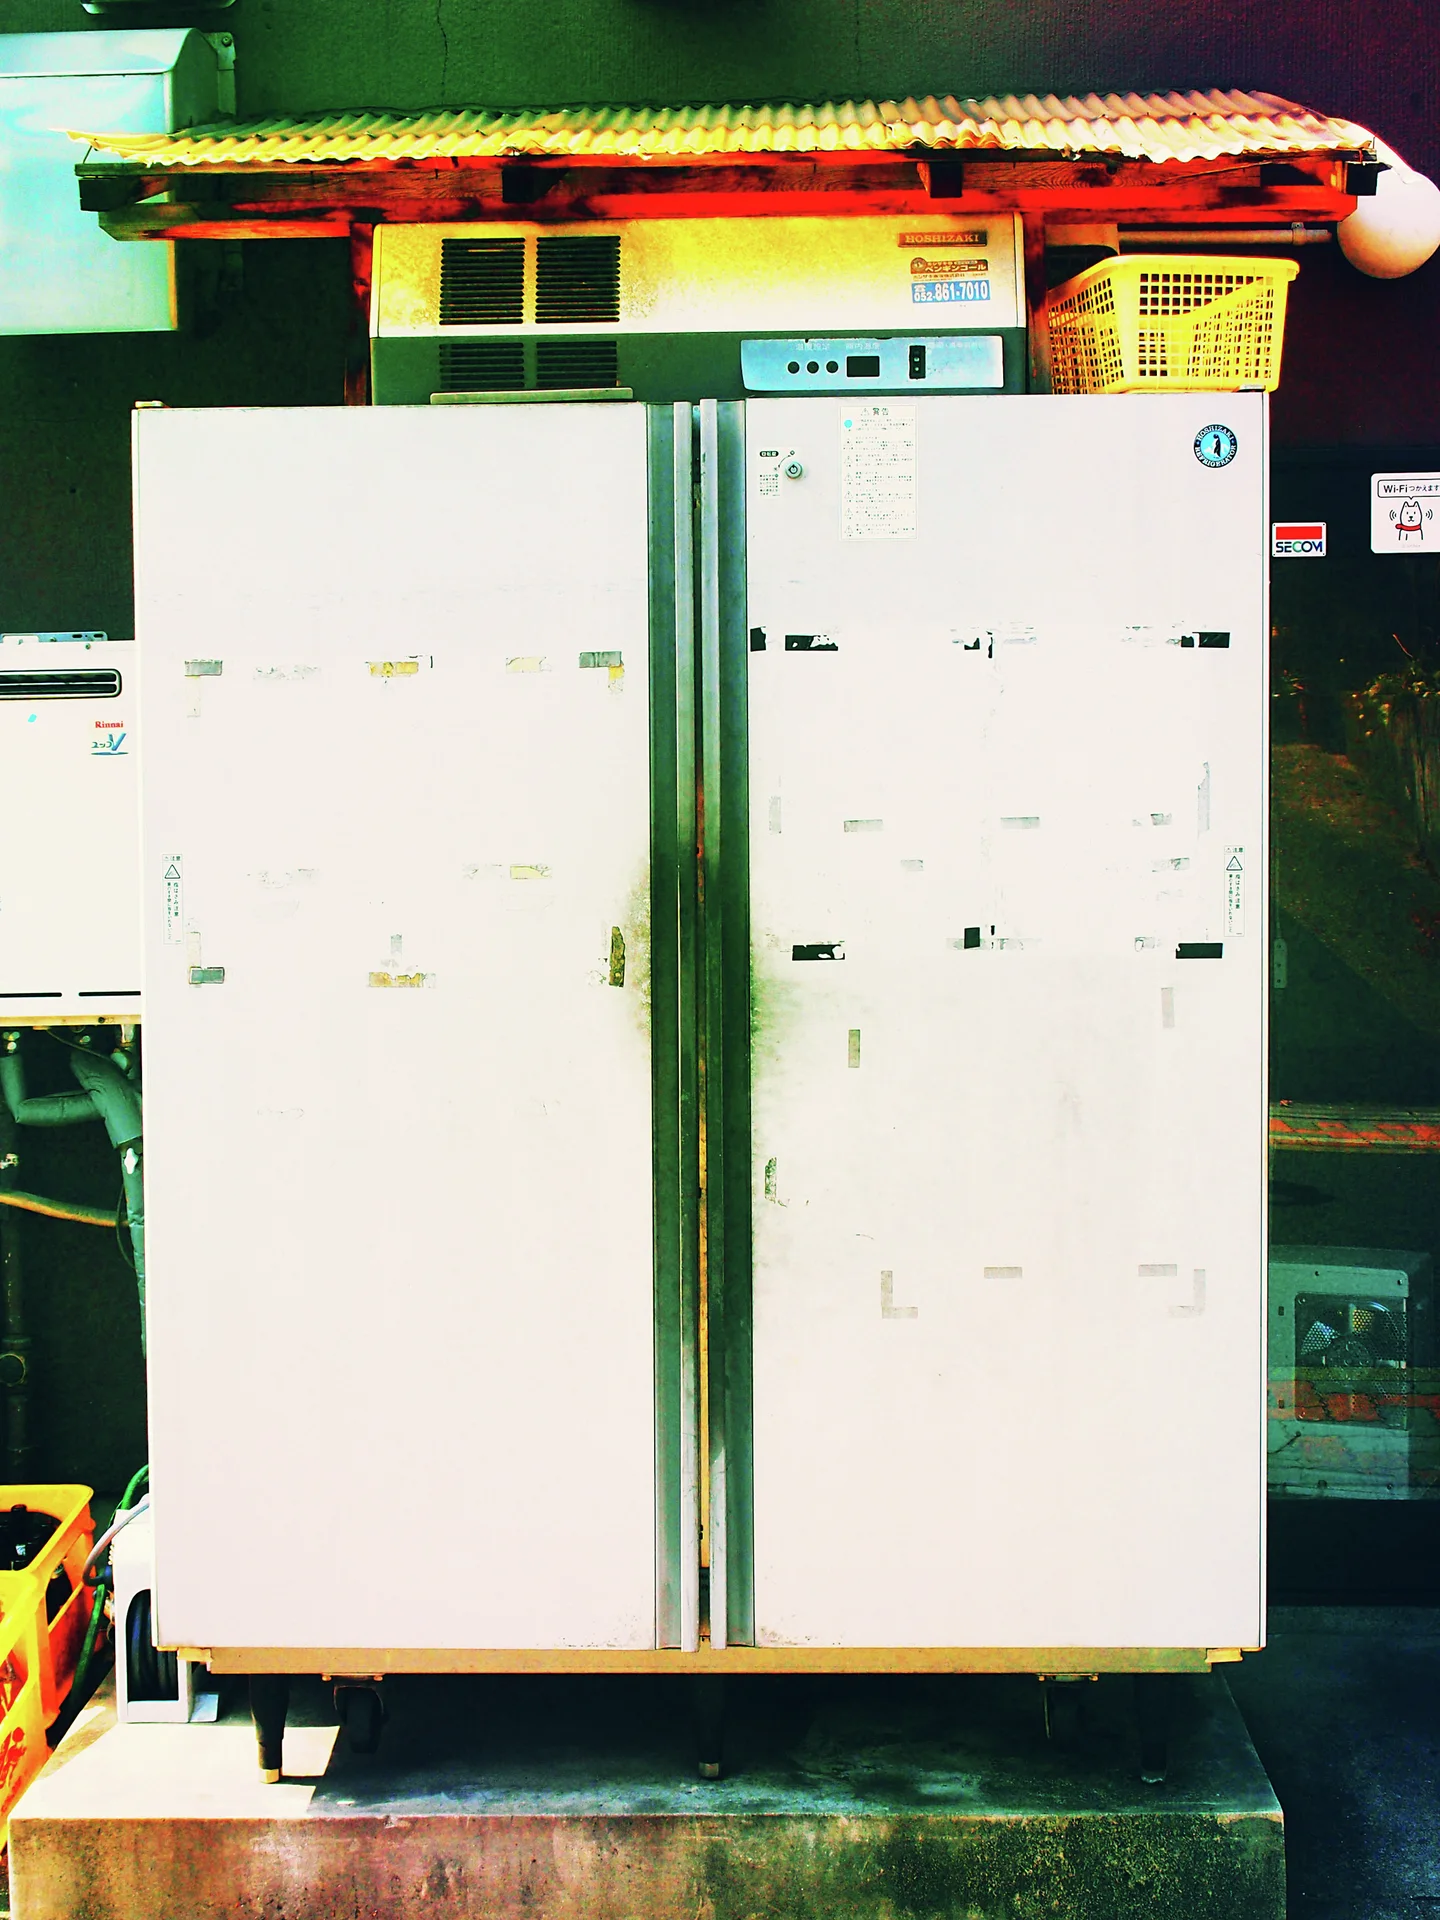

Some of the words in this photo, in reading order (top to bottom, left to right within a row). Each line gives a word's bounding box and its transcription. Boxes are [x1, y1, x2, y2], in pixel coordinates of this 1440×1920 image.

[905, 234, 979, 243] HOSHIZAKI
[925, 264, 986, 272] ペンギンコール
[914, 281, 988, 302] 052-861-7010
[1196, 426, 1235, 441] HOSHIZAKI
[1195, 444, 1236, 467] REFRIGERATOR
[1275, 541, 1323, 553] SECOM
[95, 720, 124, 728] Rinnai
